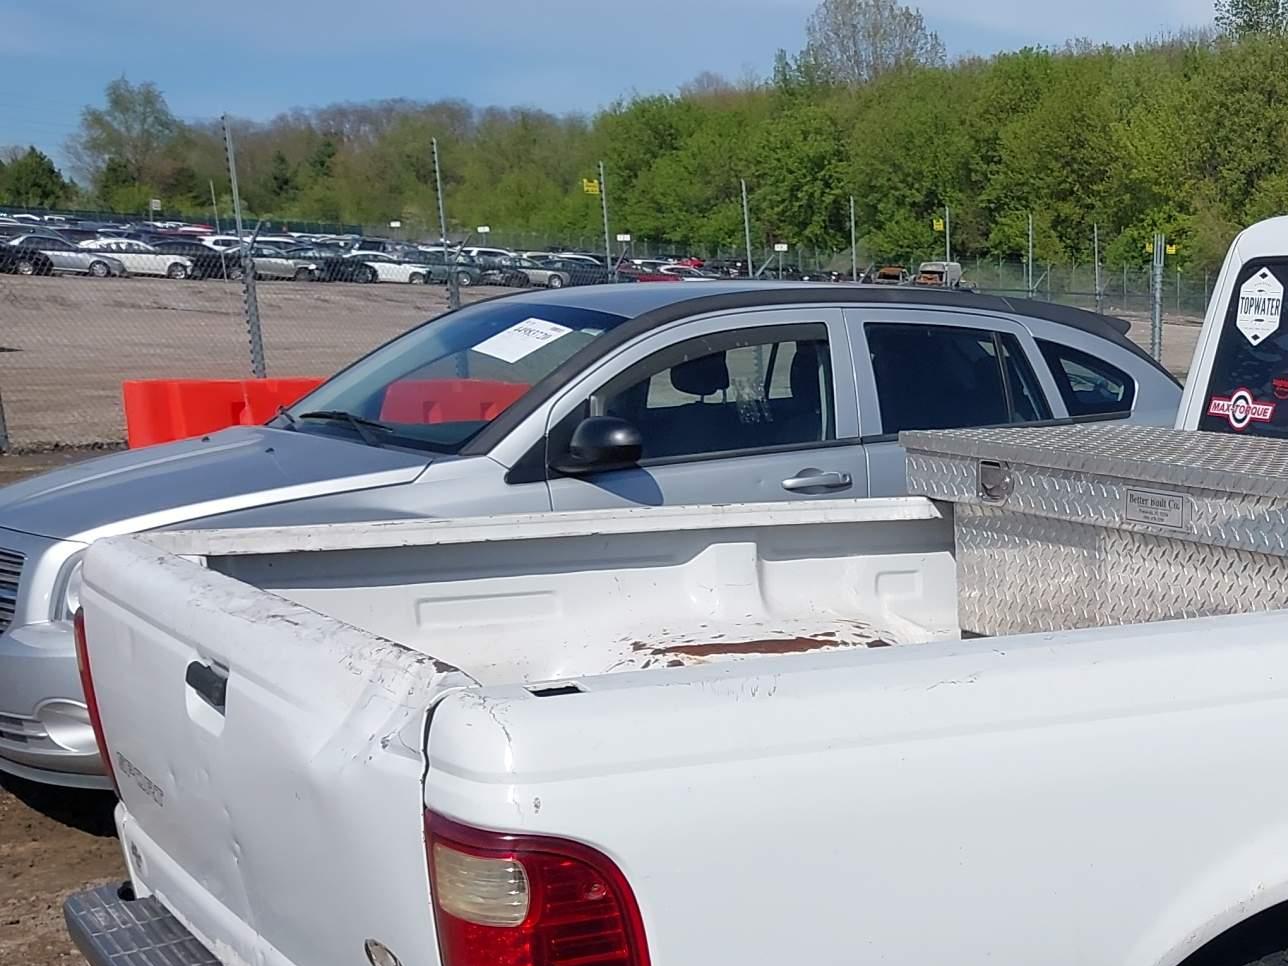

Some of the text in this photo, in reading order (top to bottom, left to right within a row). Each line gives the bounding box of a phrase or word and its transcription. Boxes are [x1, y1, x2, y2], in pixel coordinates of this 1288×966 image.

[1240, 296, 1281, 317] TOPWATER
[1212, 402, 1270, 417] MAX-TORQUE
[1129, 493, 1149, 506] Better
[1150, 498, 1167, 508] Built
